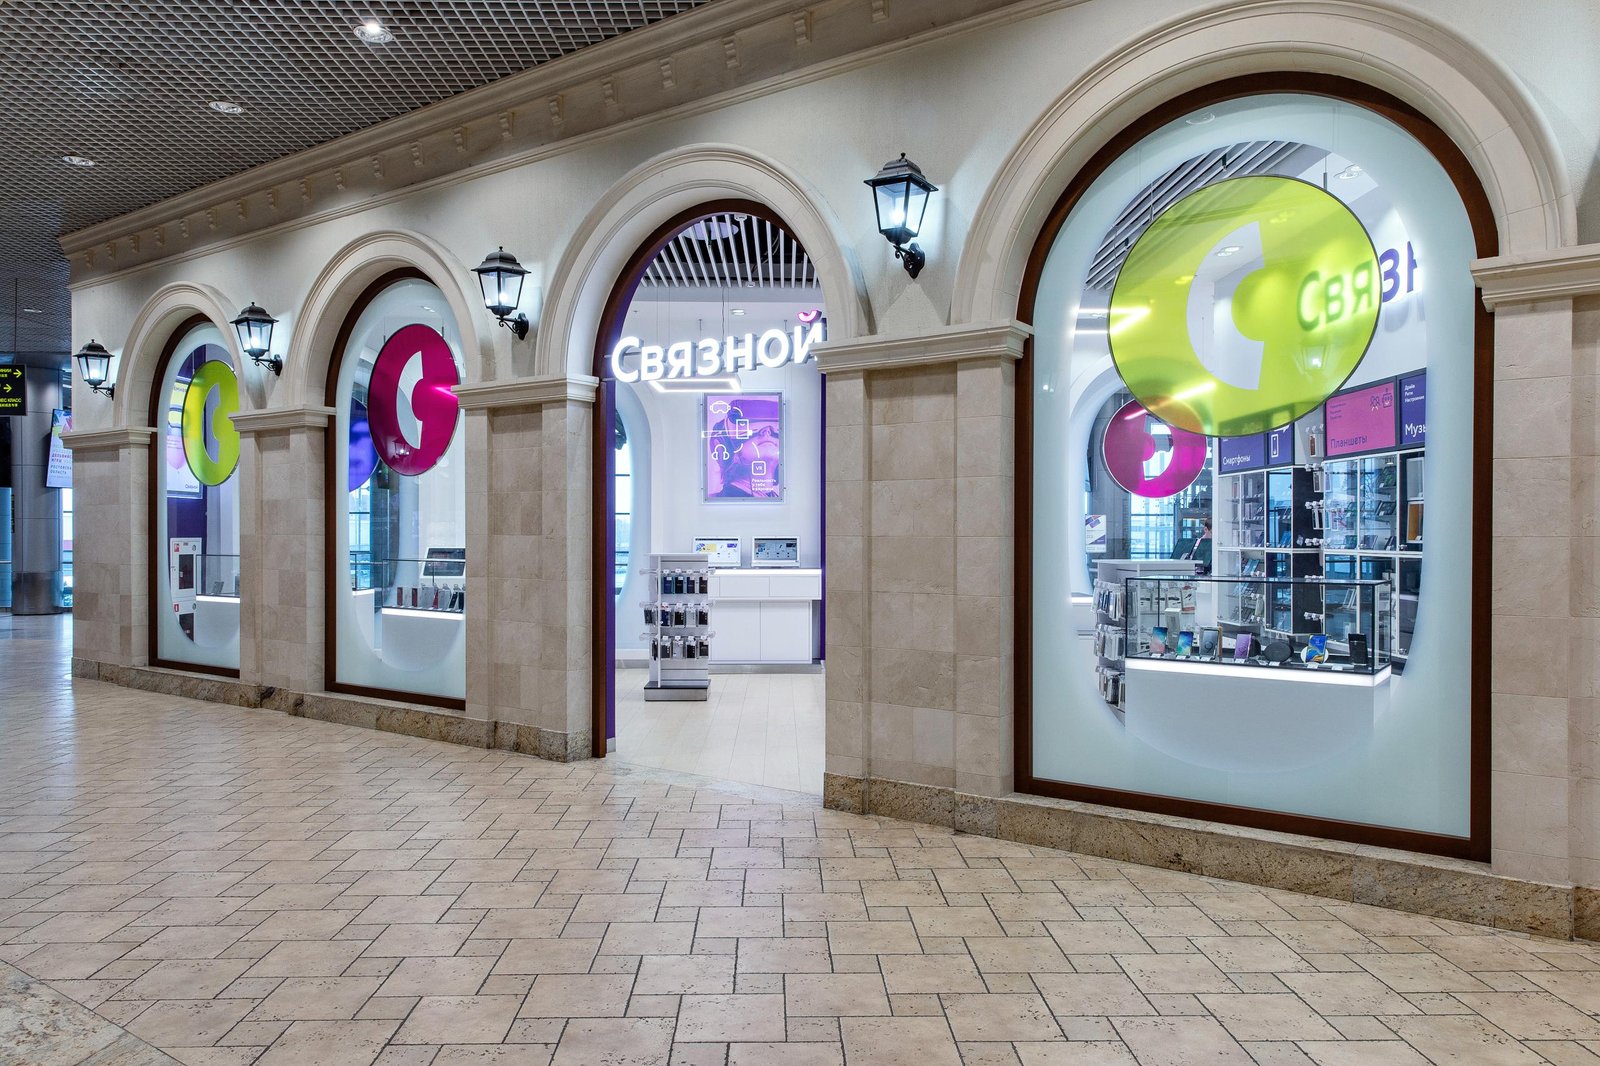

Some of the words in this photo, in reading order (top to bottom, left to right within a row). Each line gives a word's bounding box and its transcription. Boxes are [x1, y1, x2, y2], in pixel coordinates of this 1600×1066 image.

[611, 309, 827, 383] Связной
[1330, 435, 1368, 449] Планшеты
[1222, 454, 1251, 467] Смартфоны
